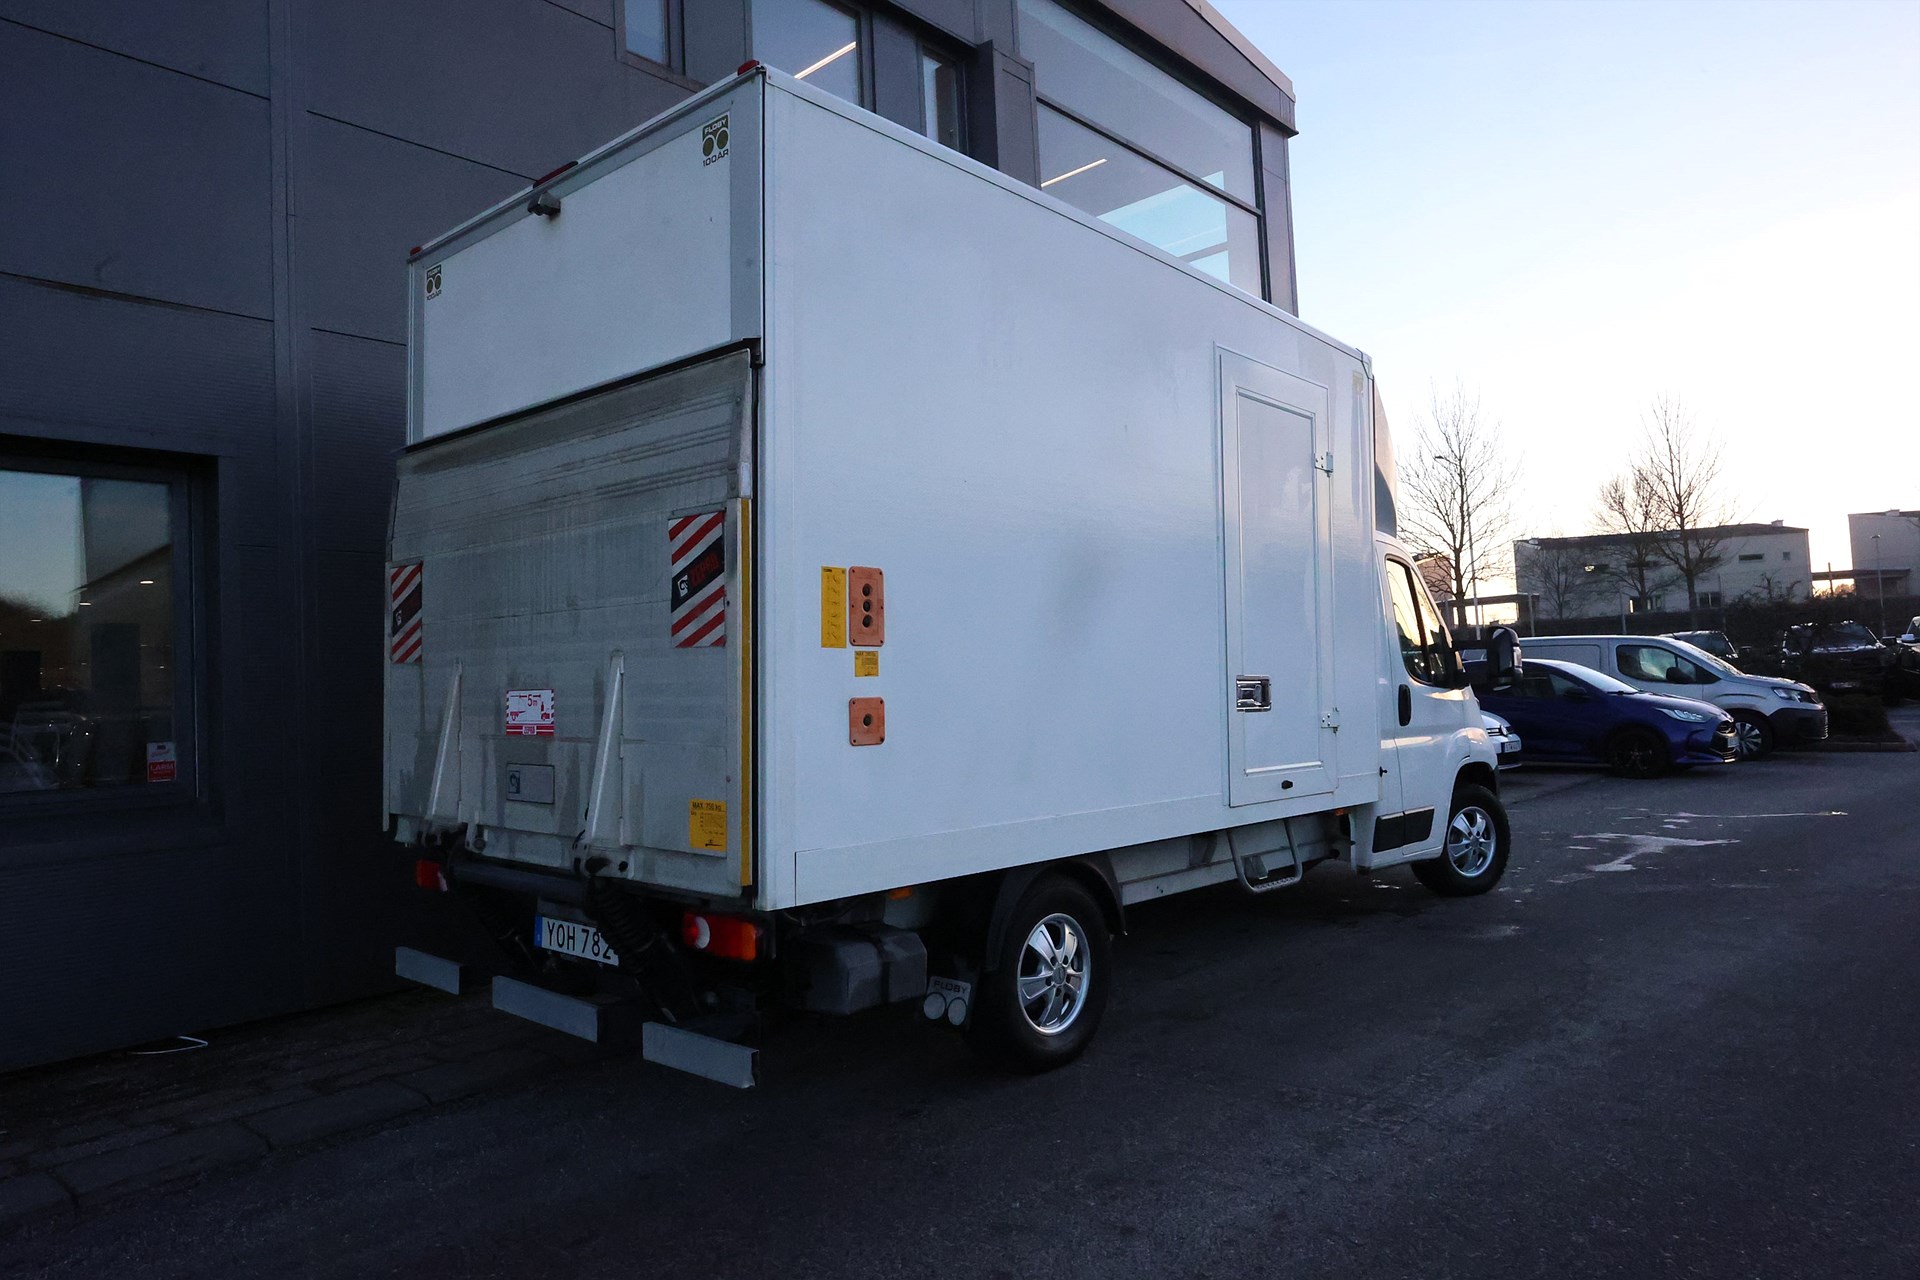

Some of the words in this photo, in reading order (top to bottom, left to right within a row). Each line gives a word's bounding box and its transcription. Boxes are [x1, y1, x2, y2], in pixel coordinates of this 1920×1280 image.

[704, 118, 727, 135] FLOBY
[547, 921, 576, 951] YOH
[934, 980, 967, 994] FLOBY
